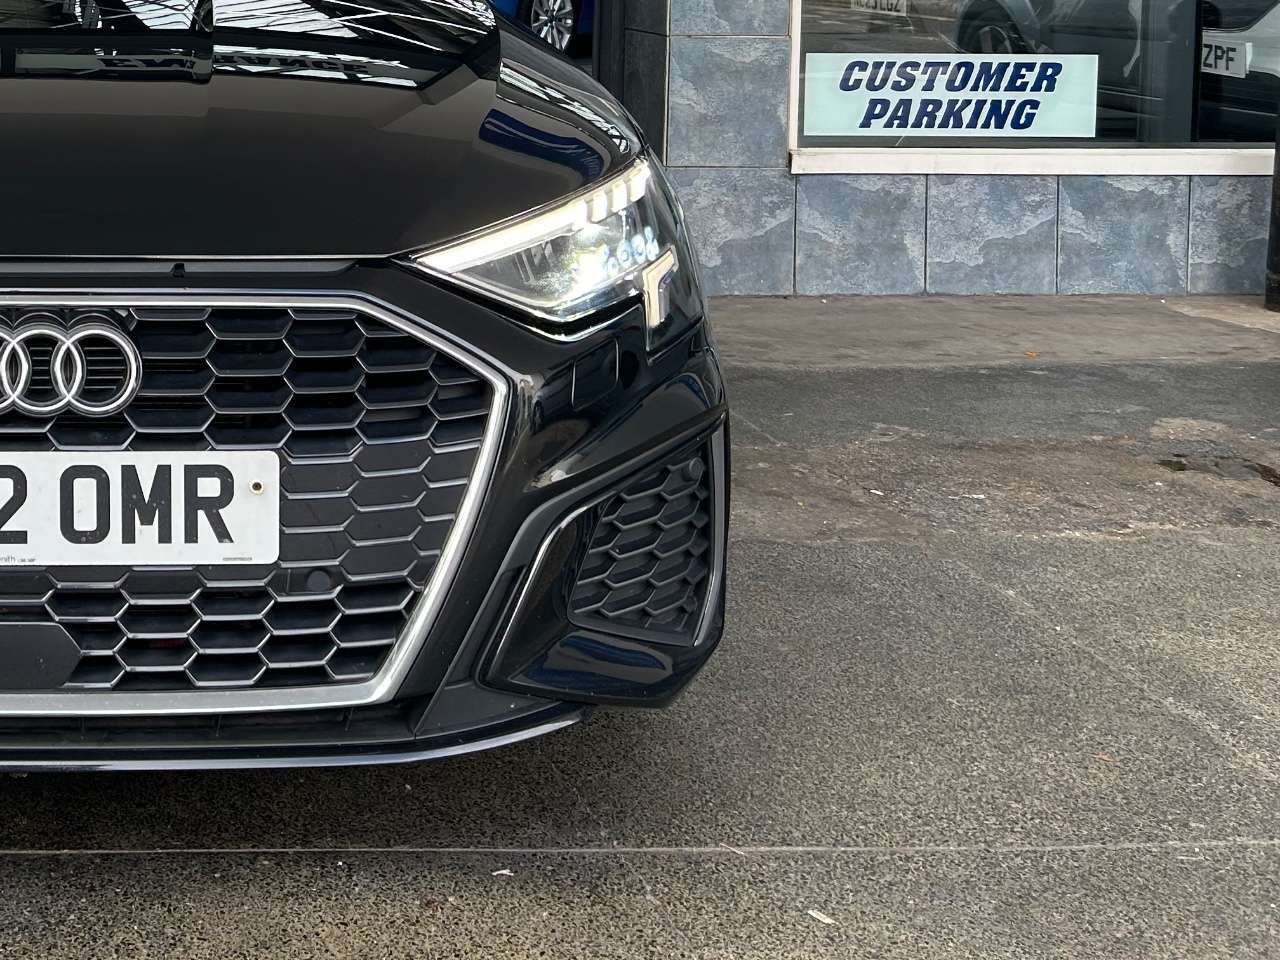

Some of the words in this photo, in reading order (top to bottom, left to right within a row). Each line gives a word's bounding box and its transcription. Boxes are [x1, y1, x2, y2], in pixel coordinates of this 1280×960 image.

[1203, 44, 1237, 71] ZPF
[839, 60, 1063, 92] CUSTOMER
[858, 98, 1041, 130] PARKING
[59, 464, 235, 544] OMR
